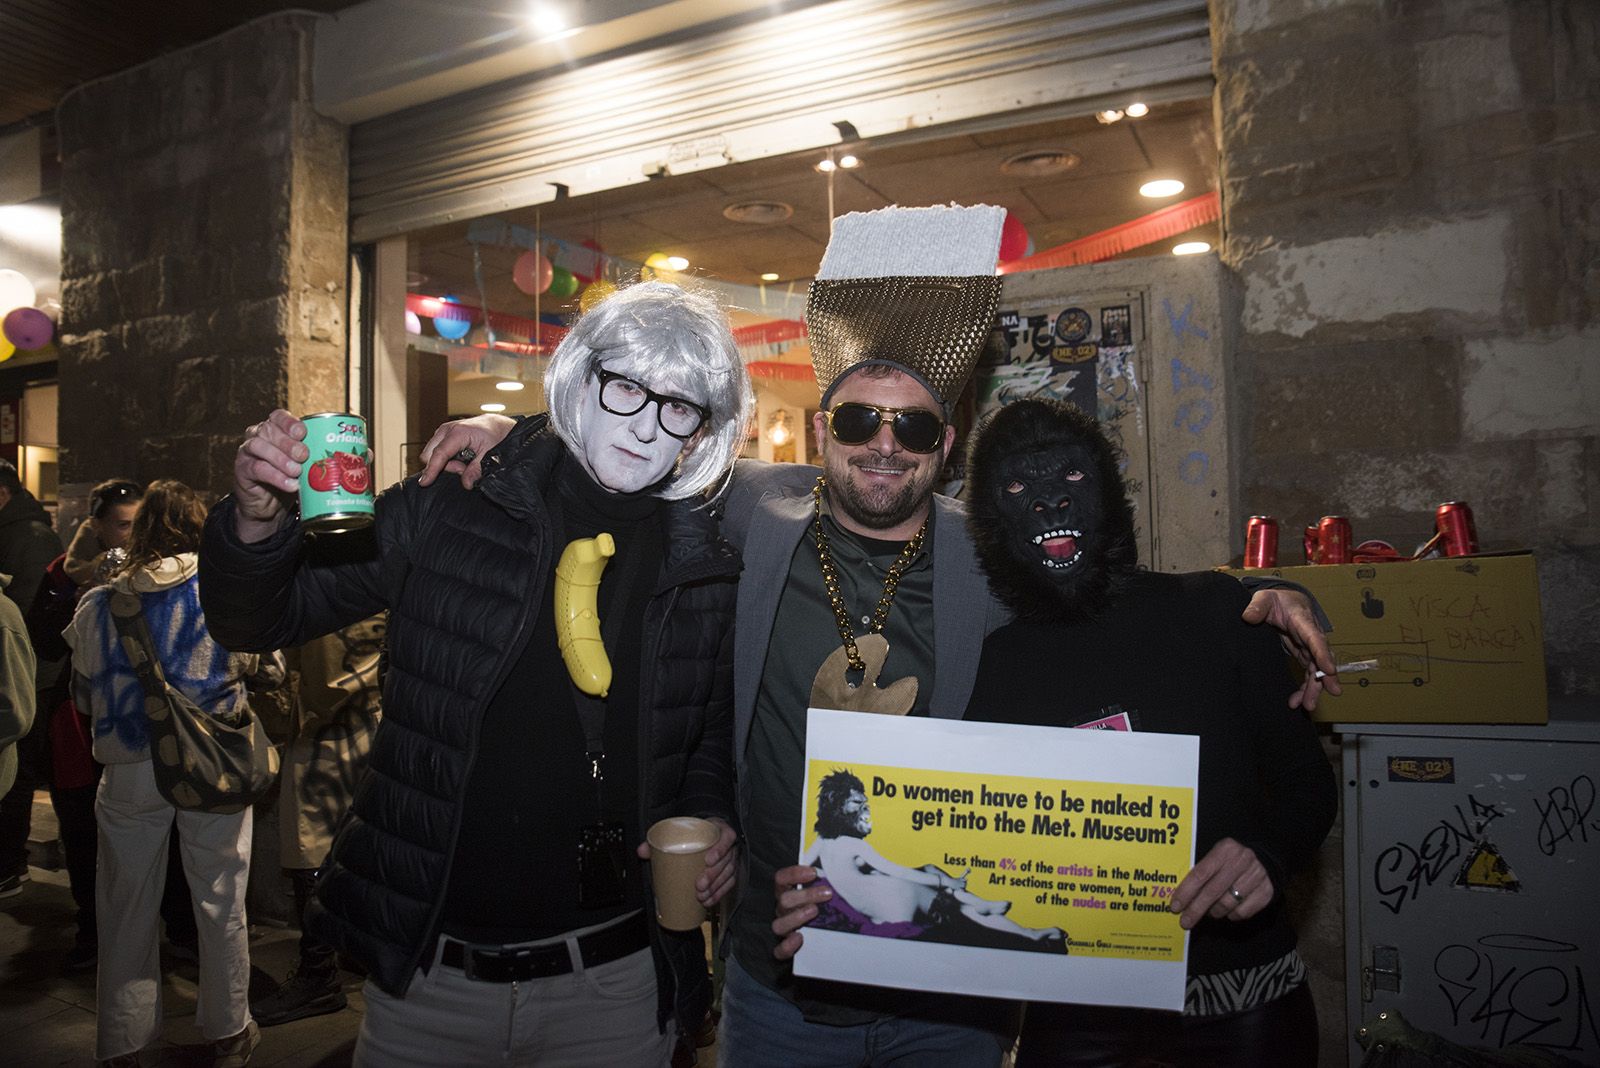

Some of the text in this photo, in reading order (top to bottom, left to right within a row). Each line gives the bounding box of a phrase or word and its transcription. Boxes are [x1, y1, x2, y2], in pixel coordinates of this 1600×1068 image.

[872, 776, 1180, 820] Do women have to be naked to
[911, 806, 1179, 845] get into the Met. Museum?
[944, 853, 1178, 884] Less than 4% of the artists in the Modern
[989, 873, 1006, 885] Art
[1009, 875, 1053, 890] sections
[1057, 881, 1076, 892] are
[1080, 883, 1125, 898] women,
[1128, 883, 1147, 897] but
[1035, 892, 1047, 905] of
[1051, 893, 1069, 906] the
[1072, 896, 1107, 910] nudes
[1110, 902, 1129, 911] are
